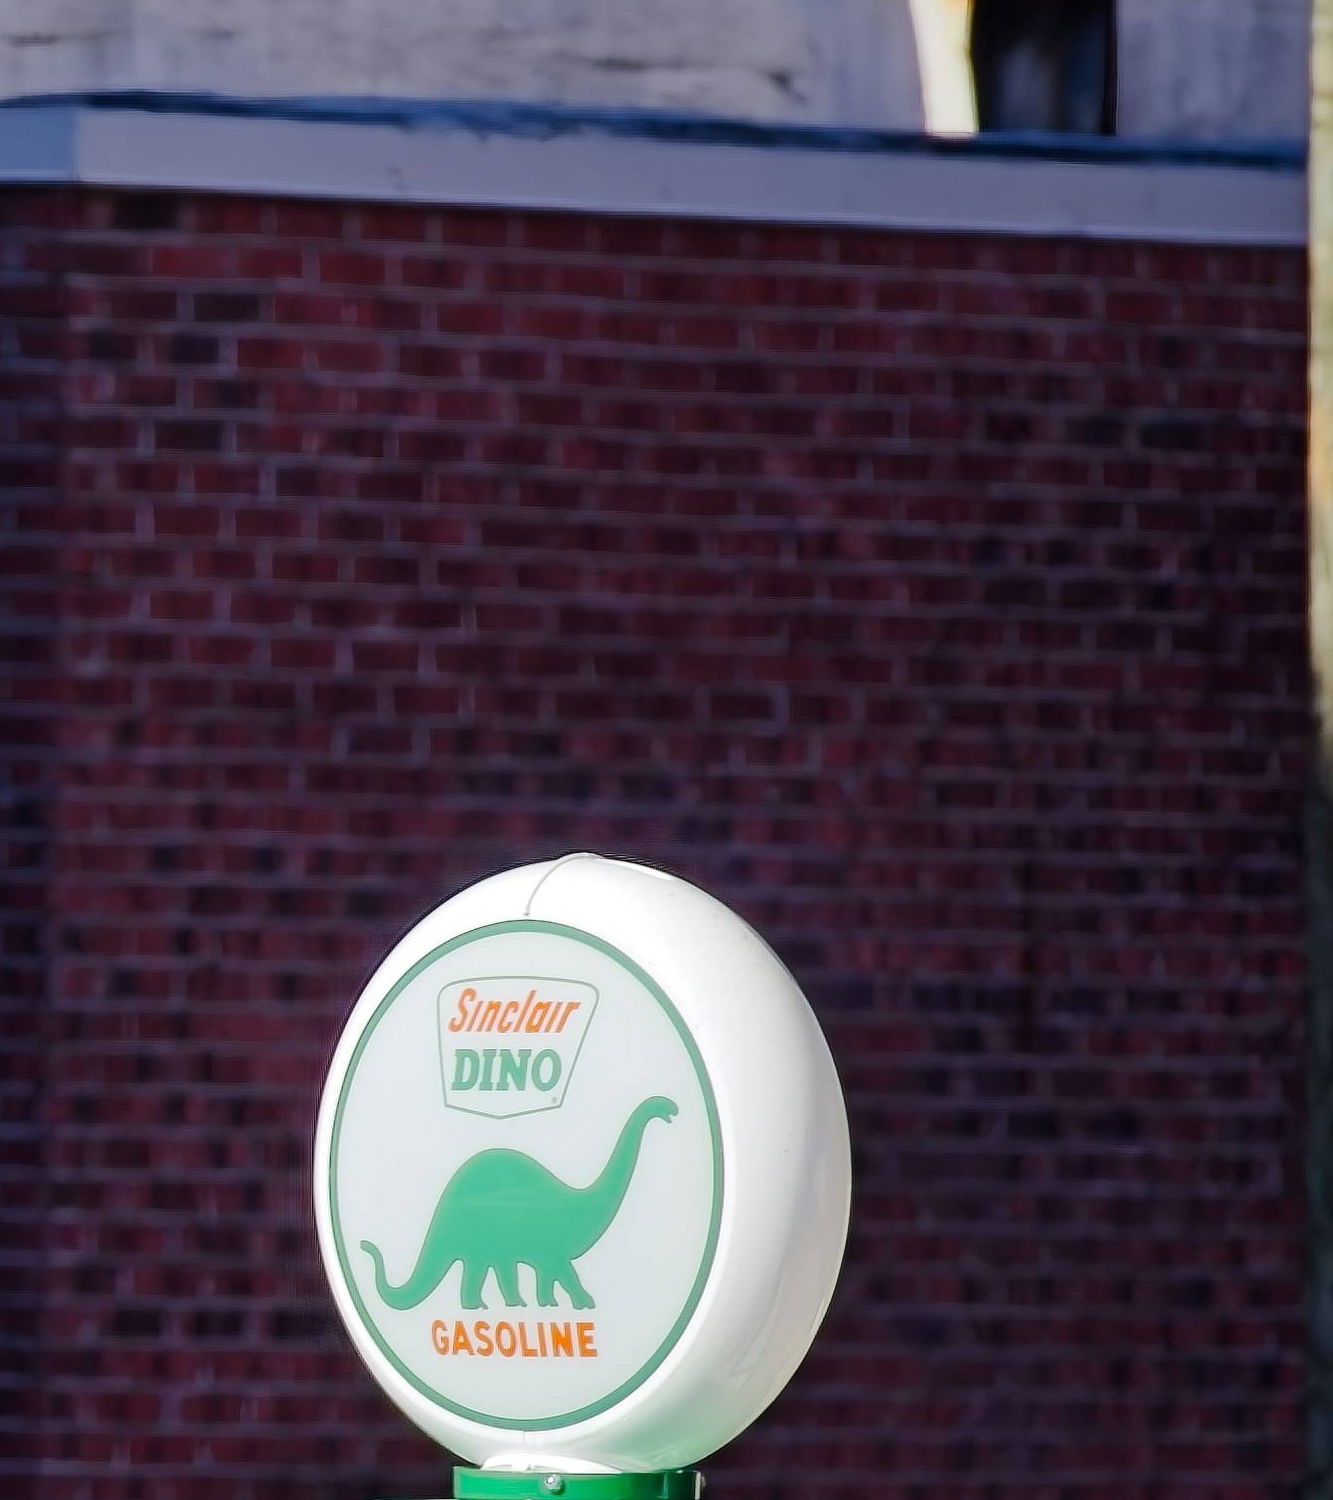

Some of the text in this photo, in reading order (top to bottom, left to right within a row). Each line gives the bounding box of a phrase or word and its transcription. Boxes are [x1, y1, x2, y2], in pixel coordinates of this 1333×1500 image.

[448, 987, 581, 1034] Sinclair
[450, 1048, 562, 1092] DINO
[430, 1318, 598, 1359] GASOLINE
